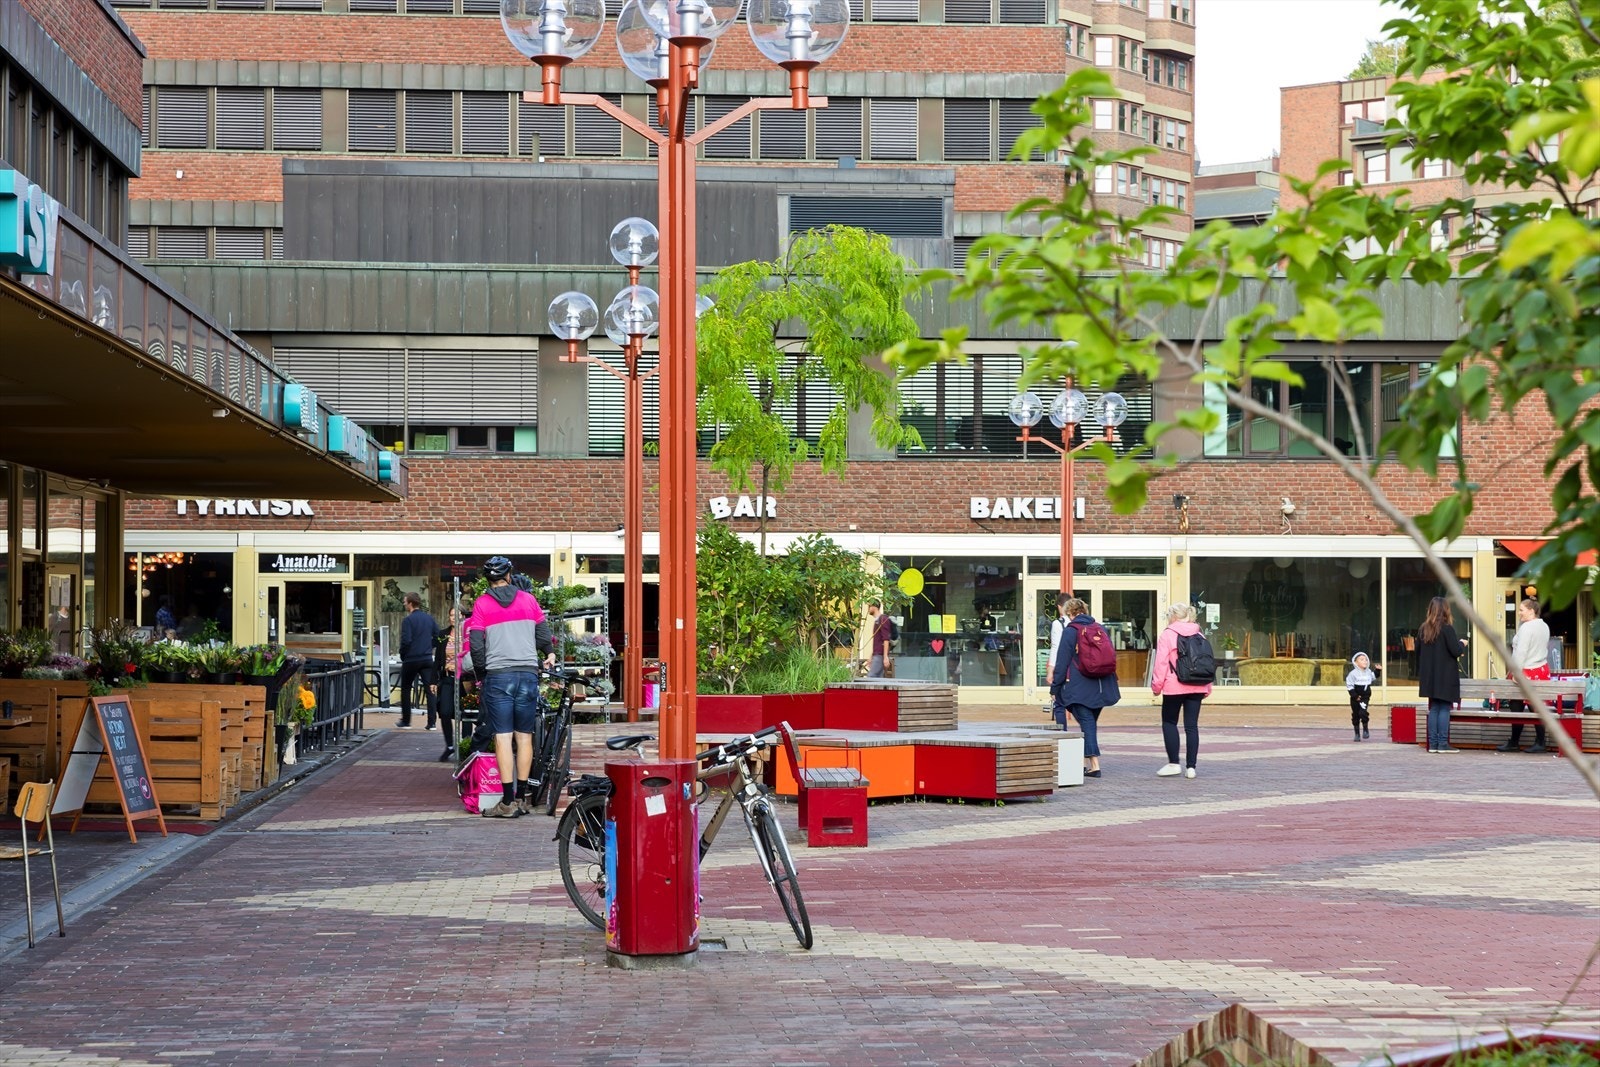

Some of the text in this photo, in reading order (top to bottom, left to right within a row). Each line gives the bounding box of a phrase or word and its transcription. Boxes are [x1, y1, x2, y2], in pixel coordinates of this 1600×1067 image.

[177, 499, 315, 516] TYRKISK
[709, 496, 777, 520] BAR
[272, 554, 337, 568] Anatolia
[481, 777, 502, 785] foodo
